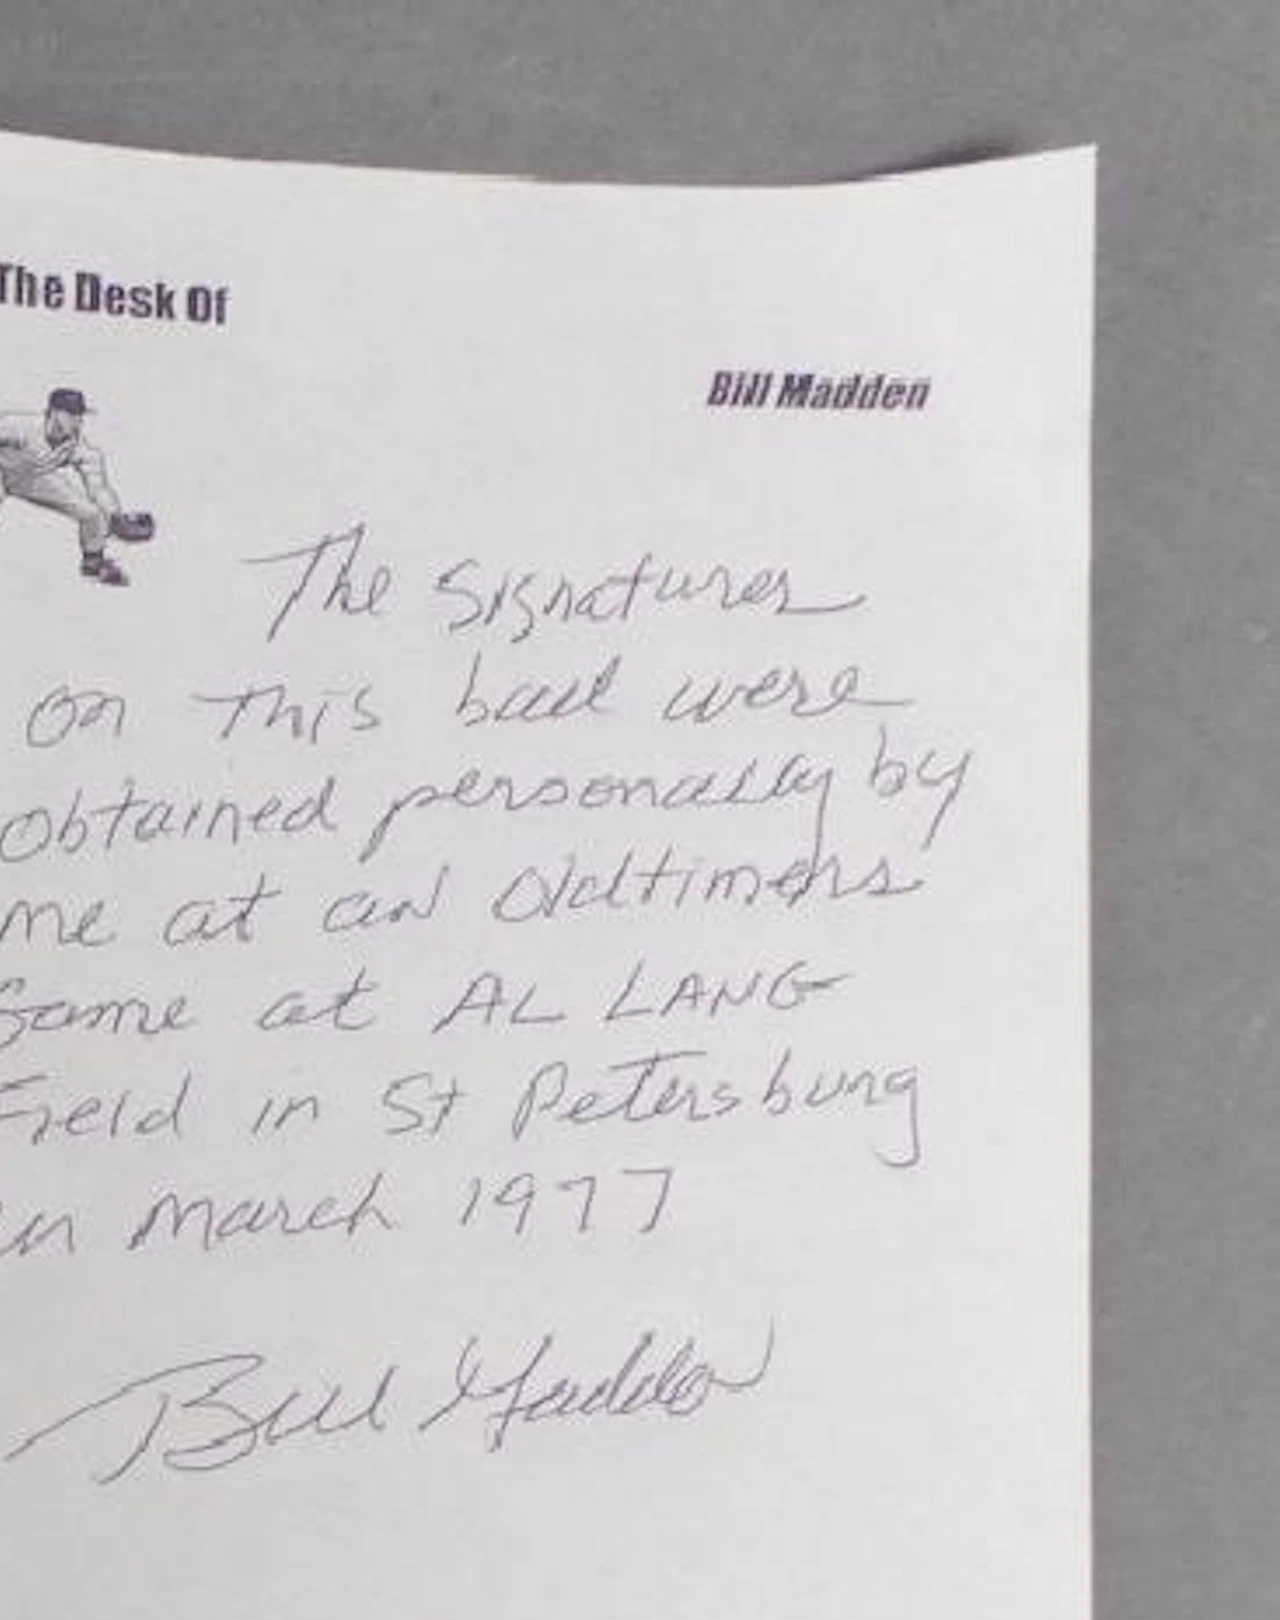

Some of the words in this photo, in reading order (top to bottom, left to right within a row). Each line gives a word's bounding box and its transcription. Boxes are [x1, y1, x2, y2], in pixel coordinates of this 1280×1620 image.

[73, 270, 177, 322] Desk
[185, 285, 229, 326] Of
[706, 370, 775, 409] Bill
[774, 372, 932, 411] Madden
[243, 524, 391, 642] The
[456, 653, 620, 727] ball
[661, 663, 914, 719] were
[359, 753, 834, 900] personally
[868, 726, 972, 851] by
[163, 872, 283, 947] at
[259, 967, 380, 1031] at
[430, 971, 564, 1034] AL
[605, 962, 854, 1020] LANG
[252, 1090, 319, 1136] in
[512, 1047, 920, 1168] Petersburg
[458, 1168, 673, 1235] 1977
